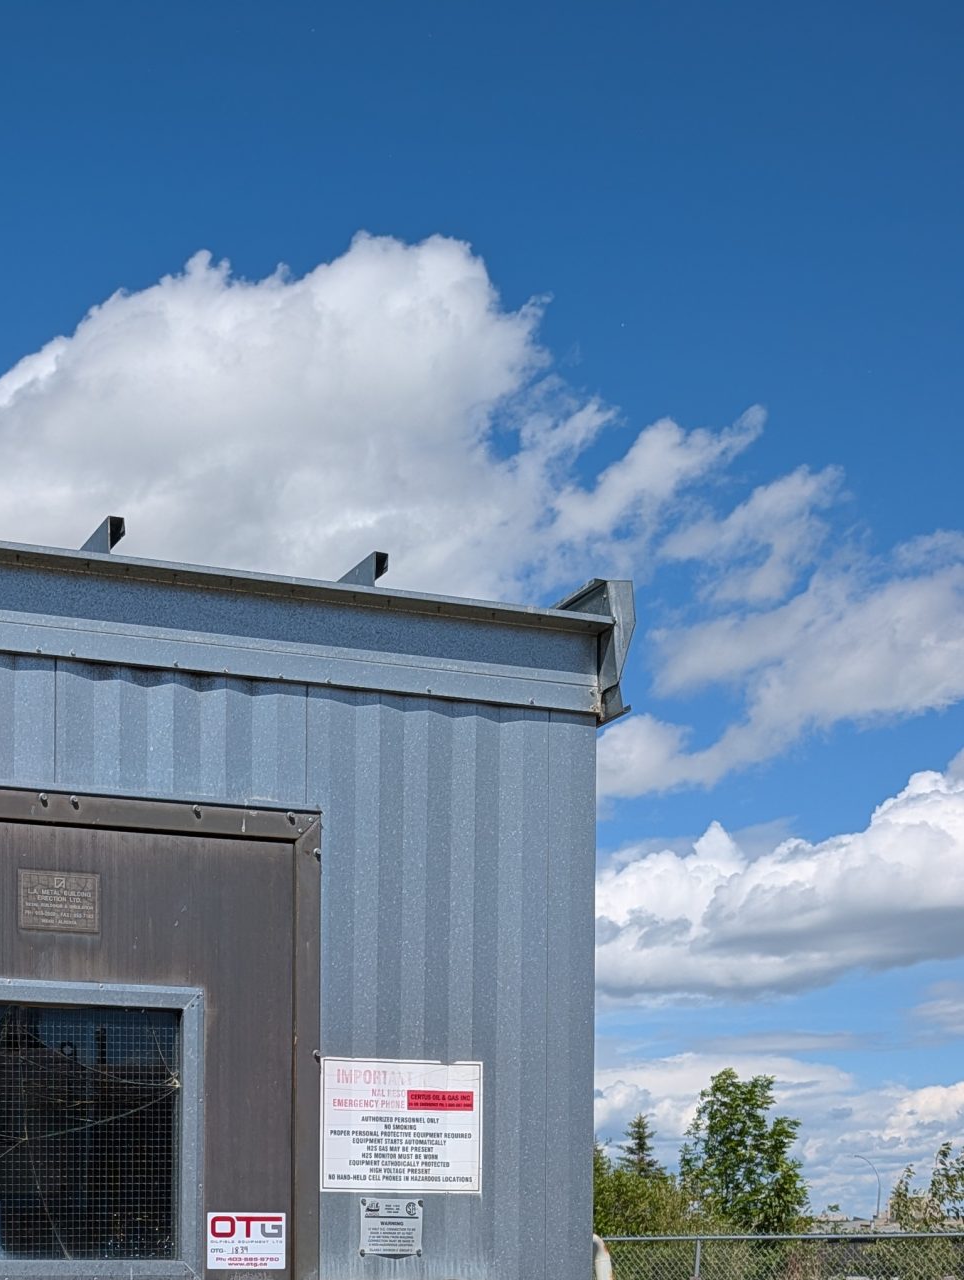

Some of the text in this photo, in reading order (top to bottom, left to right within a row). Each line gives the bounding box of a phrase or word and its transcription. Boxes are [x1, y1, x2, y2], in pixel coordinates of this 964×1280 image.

[372, 1088, 386, 1098] NAL
[332, 1098, 406, 1109] EMERGENCY PHONE
[210, 1216, 282, 1238] OTG
